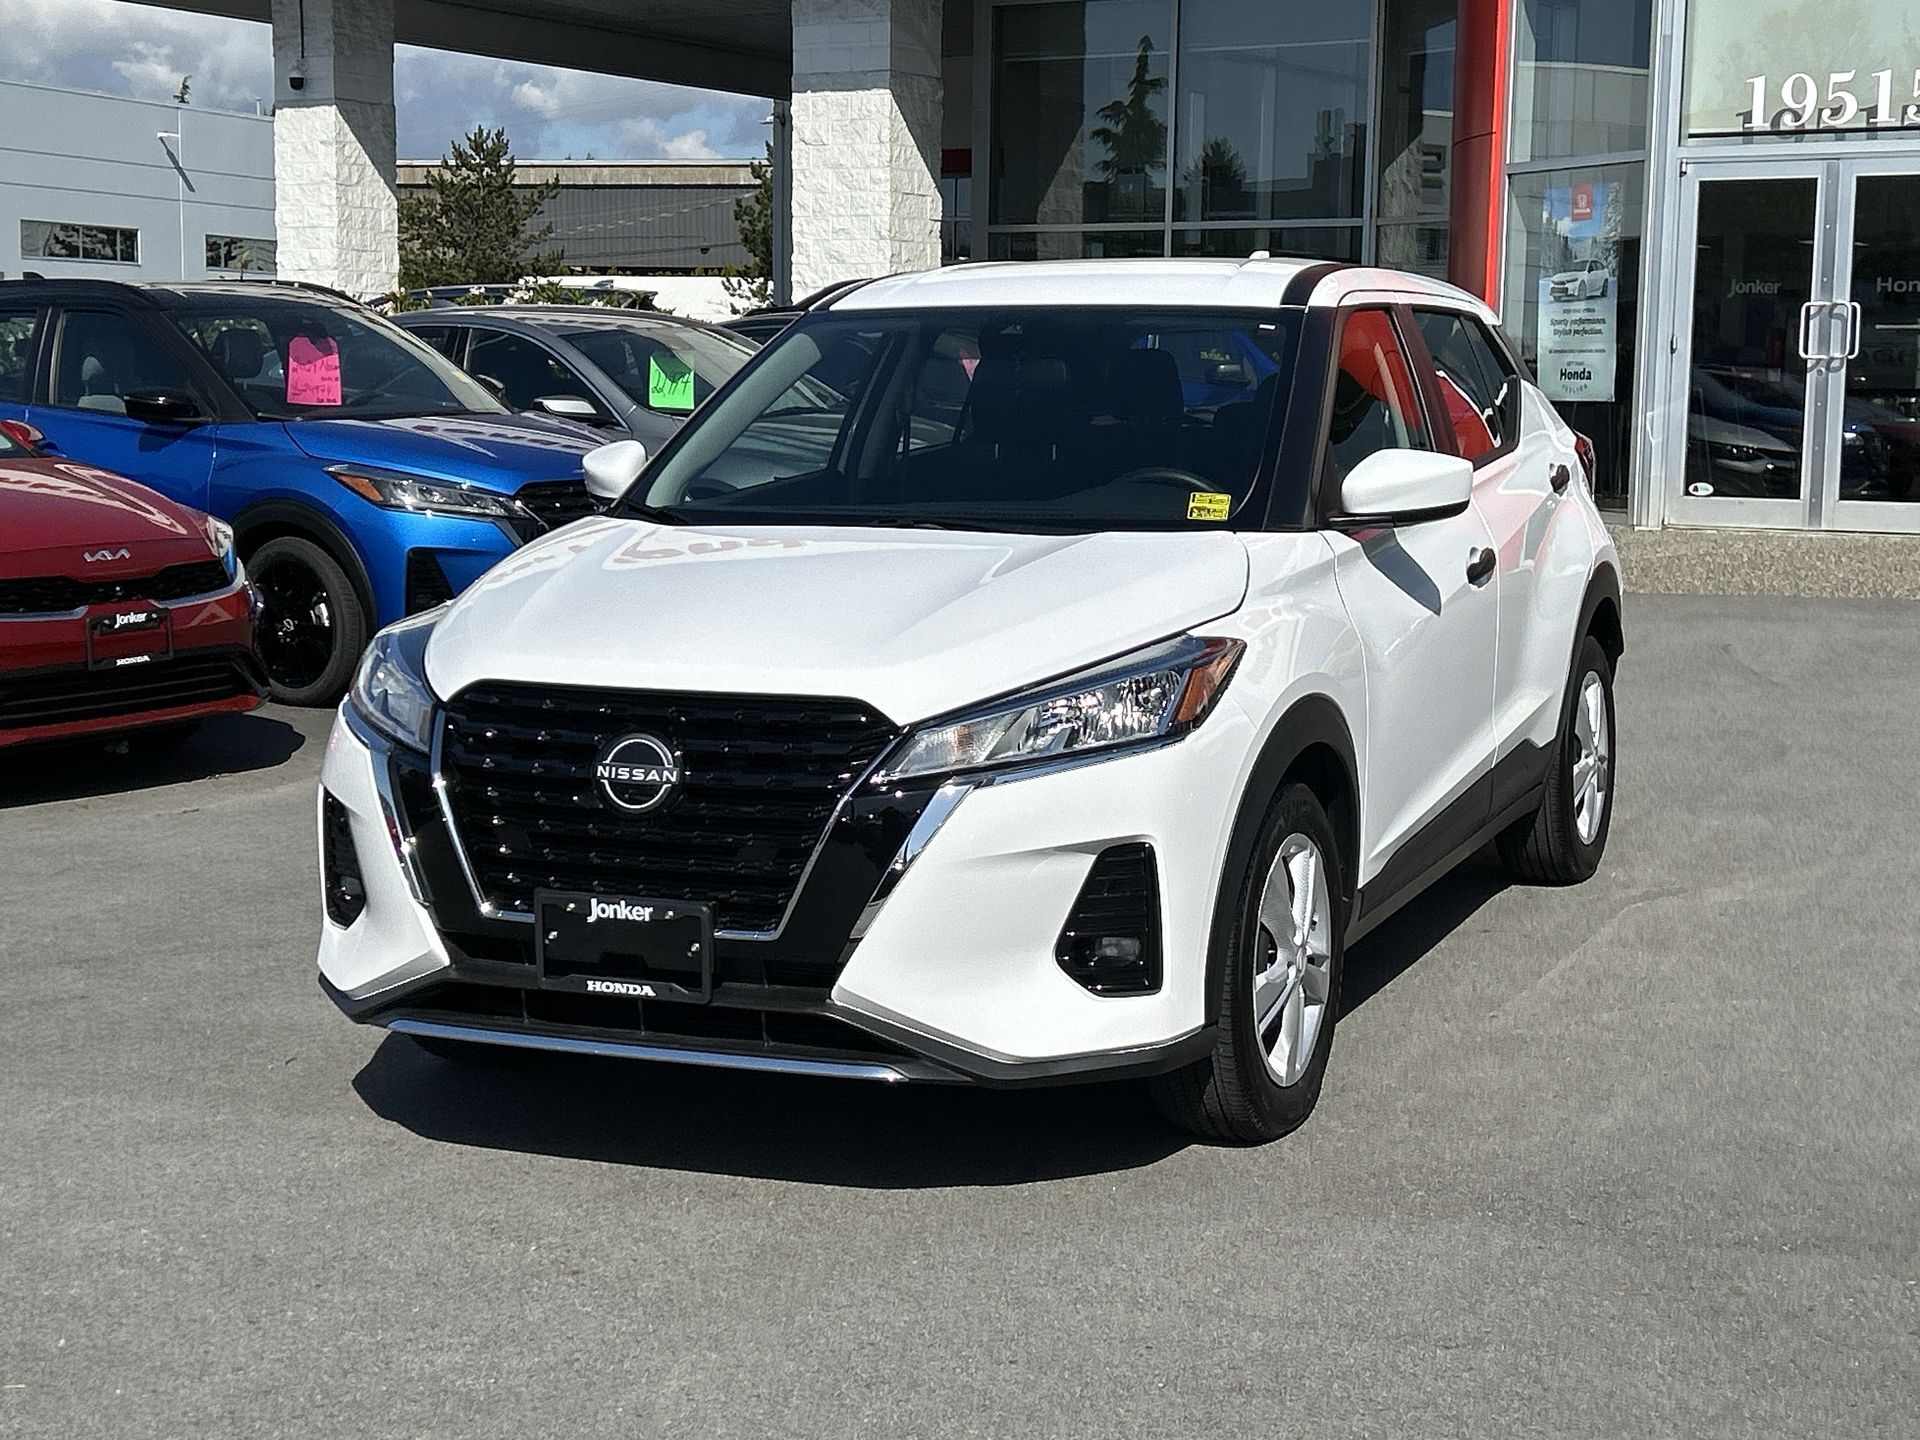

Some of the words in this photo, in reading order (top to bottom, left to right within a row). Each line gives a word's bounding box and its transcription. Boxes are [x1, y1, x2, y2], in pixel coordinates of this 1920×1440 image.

[1728, 279, 1781, 298] Jonker
[1560, 367, 1592, 381] Honda
[114, 612, 148, 629] Jonker
[116, 655, 151, 666] HONDA
[596, 765, 678, 782] NISSAN
[587, 898, 654, 923] Jonker
[587, 980, 657, 997] HONDA
